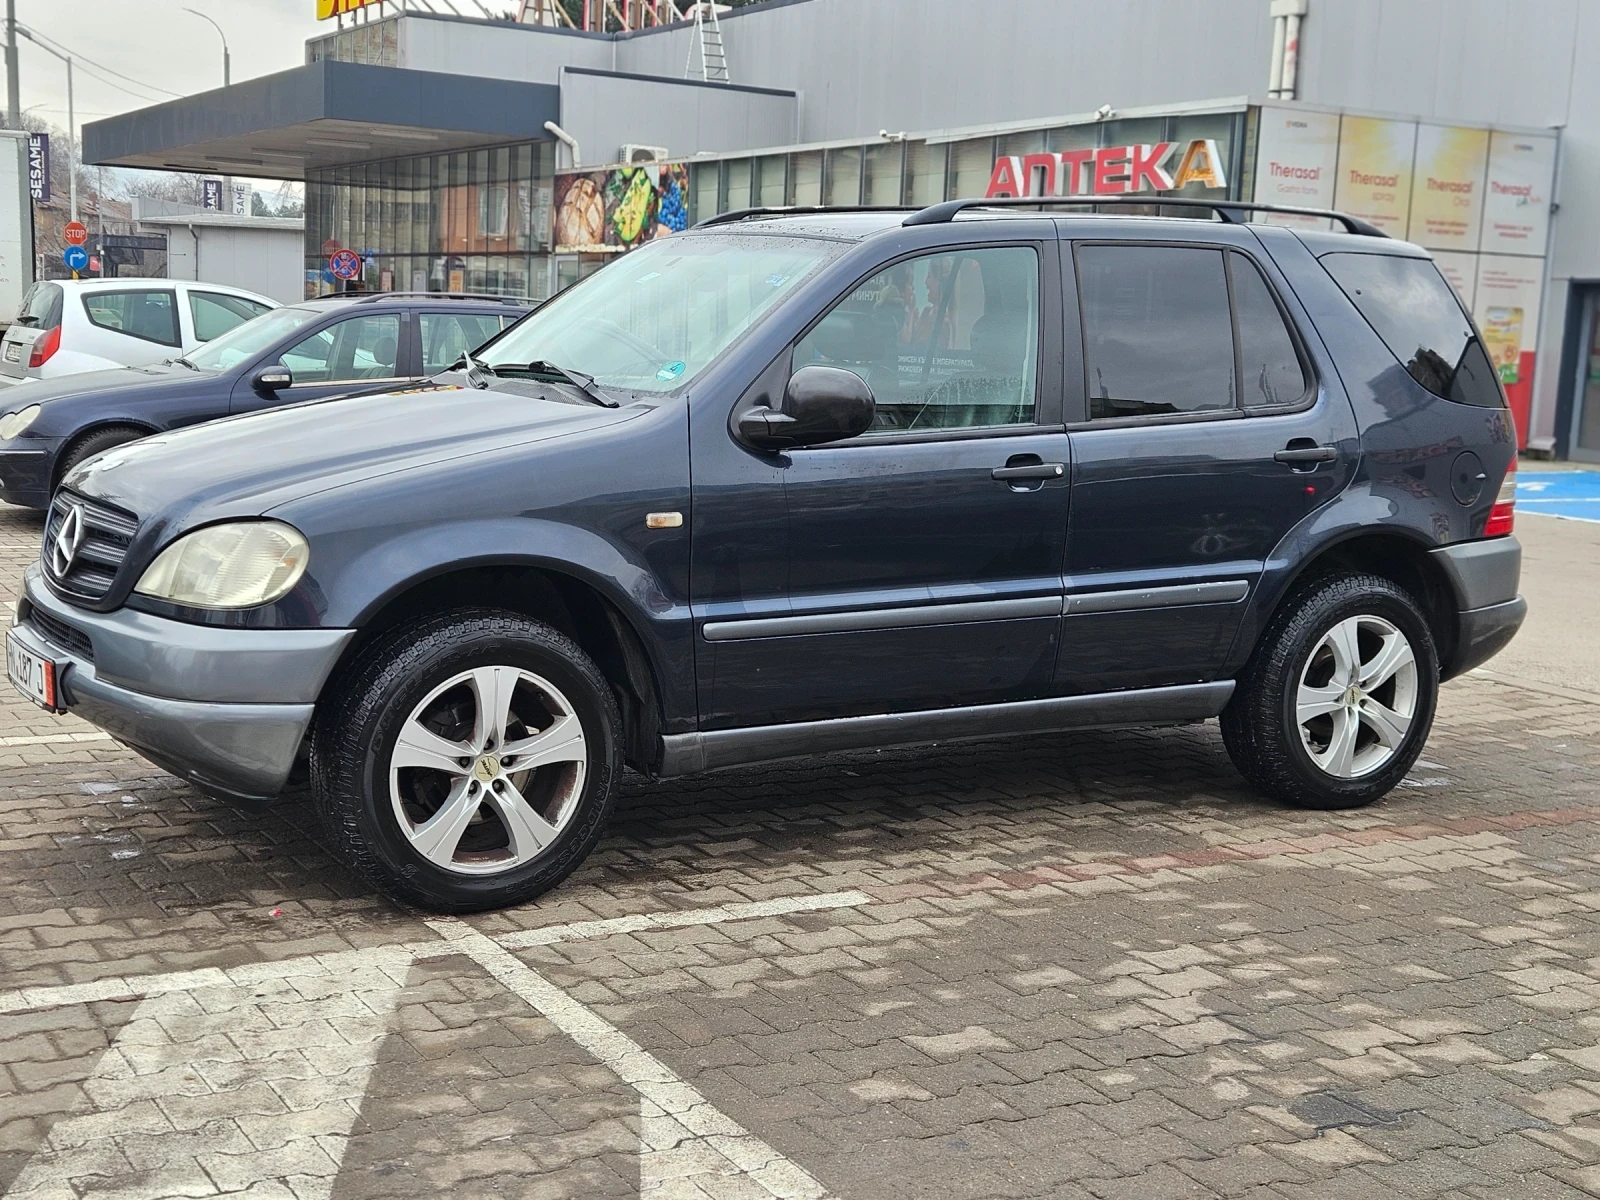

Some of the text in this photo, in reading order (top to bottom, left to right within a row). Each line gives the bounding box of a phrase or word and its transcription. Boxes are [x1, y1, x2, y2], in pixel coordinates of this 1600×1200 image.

[29, 135, 43, 199] SESAME
[984, 139, 1227, 198] АПТЕКА
[1269, 162, 1321, 181] Therasal
[1349, 170, 1398, 187] Therasal
[1427, 177, 1473, 194] Therasal
[1491, 181, 1532, 197] Therasal
[66, 229, 86, 239] STOP
